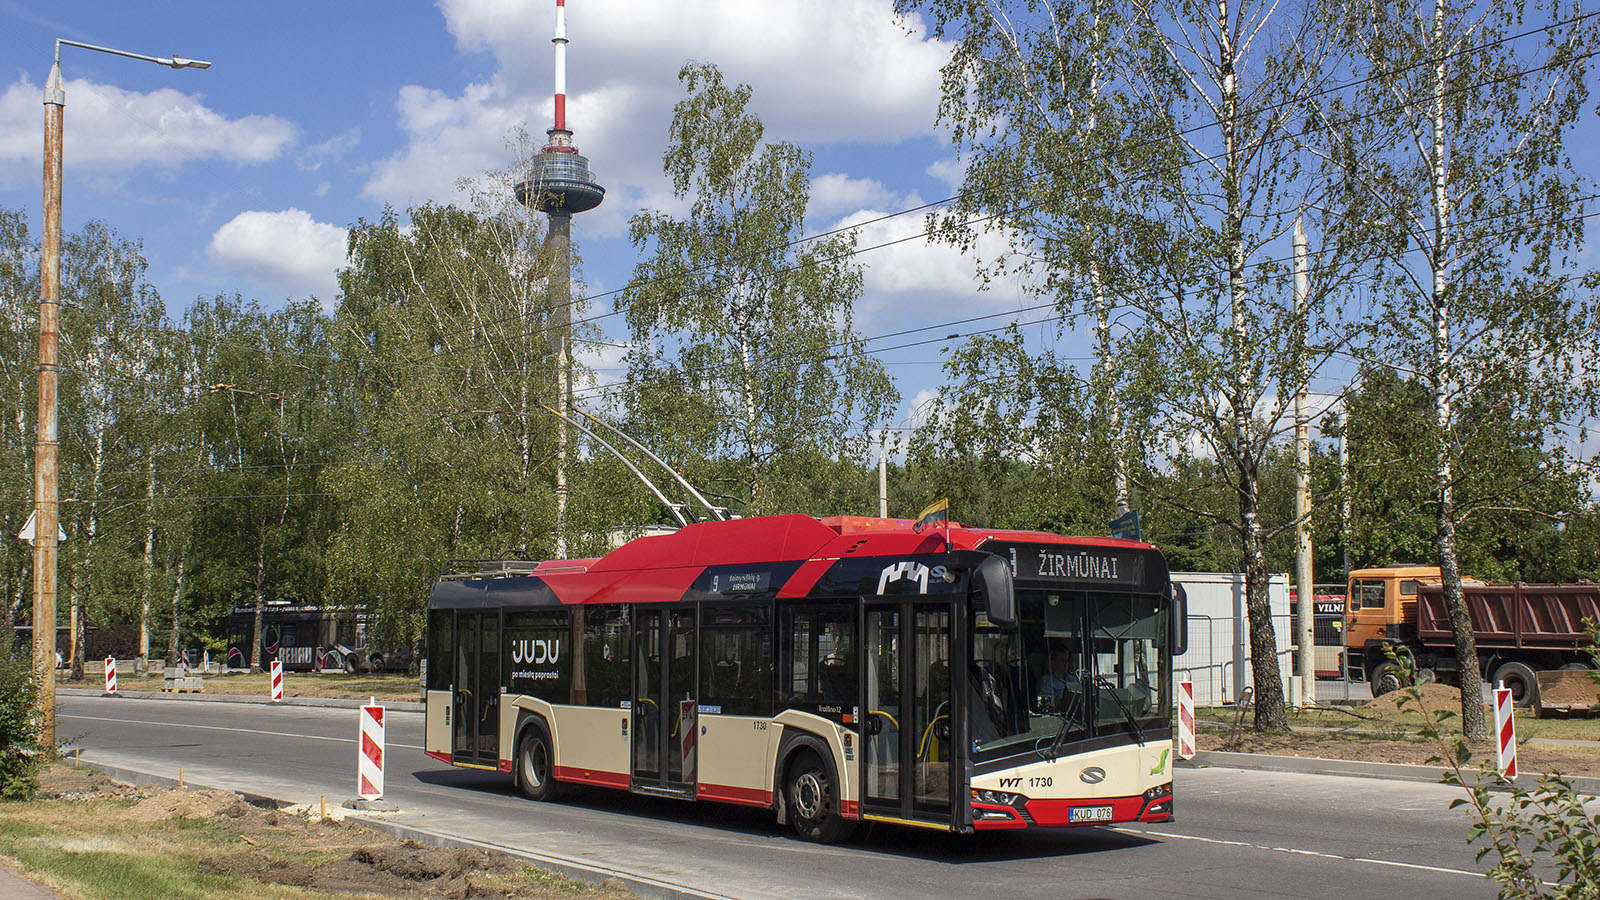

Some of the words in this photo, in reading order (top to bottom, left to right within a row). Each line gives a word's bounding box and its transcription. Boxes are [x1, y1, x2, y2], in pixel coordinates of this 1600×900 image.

[1038, 549, 1118, 579] ŽIRMŪNAI
[713, 576, 718, 592] 9
[279, 647, 312, 663] REHAU
[512, 640, 560, 664] JUDU
[753, 721, 766, 730] 1730
[1029, 777, 1053, 788] 1730
[1074, 809, 1092, 819] KUD
[1096, 808, 1111, 818] 076
